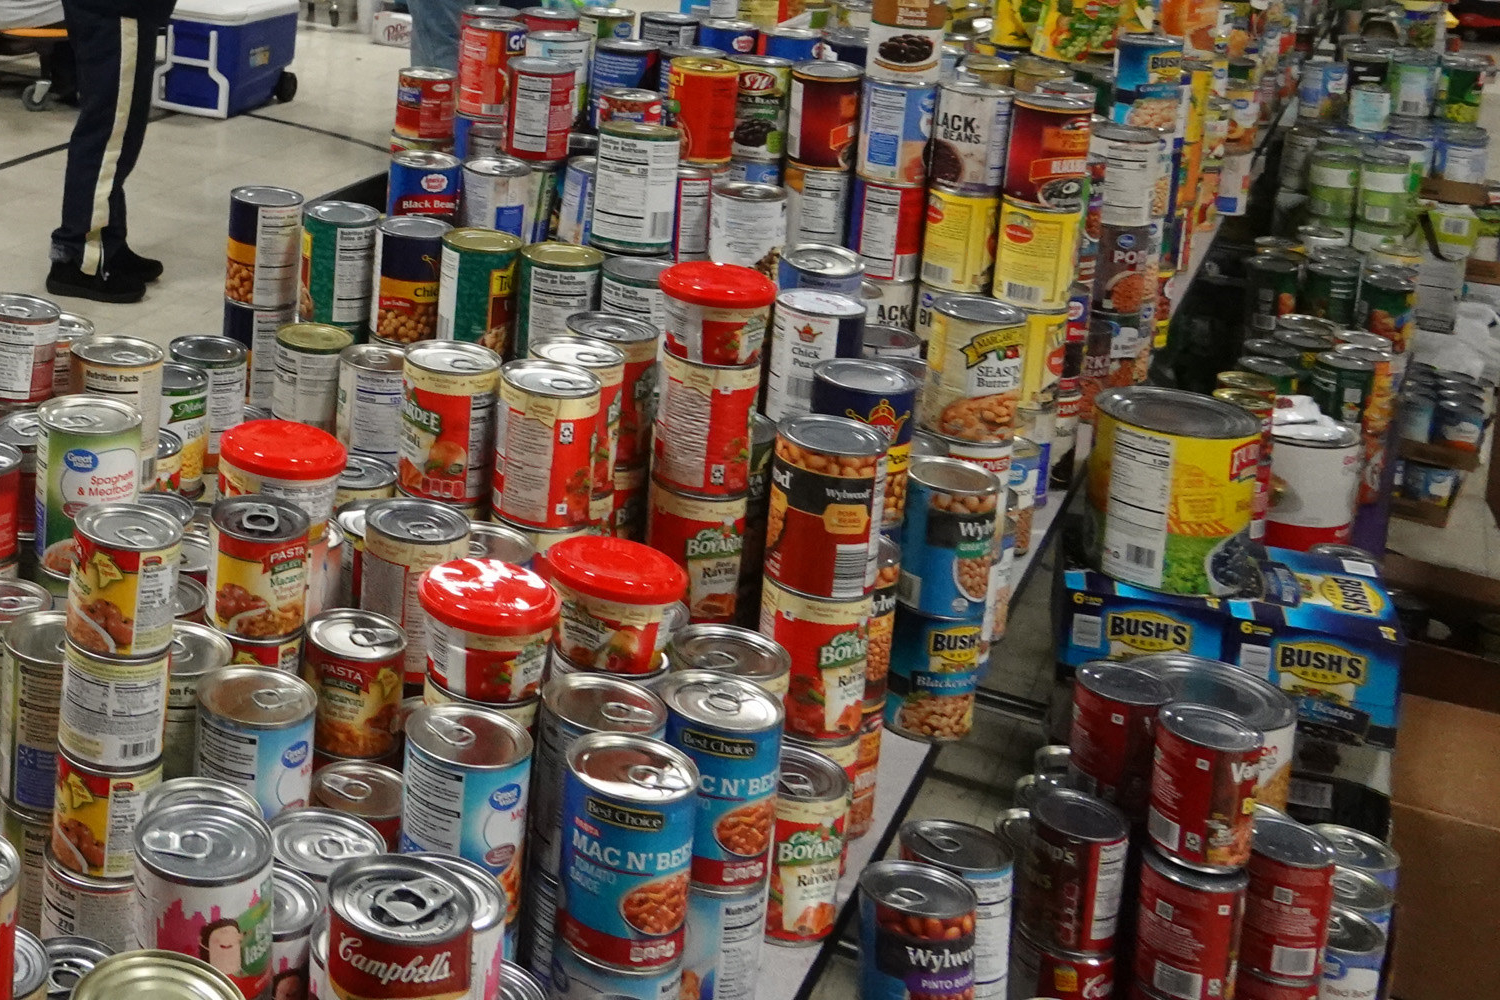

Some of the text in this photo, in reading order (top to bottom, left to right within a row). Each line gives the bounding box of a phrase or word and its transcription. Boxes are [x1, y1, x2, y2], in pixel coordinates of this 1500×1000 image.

[943, 130, 982, 145] BEANS
[402, 199, 429, 210] Black
[792, 346, 820, 359] Chick
[86, 369, 140, 383] Nutrition Facts
[977, 378, 1010, 388] Butter
[67, 451, 93, 463] Great
[77, 481, 134, 497] & Meatballs
[270, 546, 305, 563] PASTA
[1073, 590, 1085, 605] 6
[1111, 616, 1188, 647] BUSH'S
[1240, 620, 1252, 634] 6
[1280, 645, 1363, 680] BUSH'S
[321, 663, 364, 684] PASTA
[683, 732, 755, 756] Best Choice
[587, 800, 663, 829] Best Choice
[573, 828, 621, 866] MAC
[626, 851, 654, 870] N'
[58, 918, 75, 931] 270
[338, 932, 454, 985] Campbell's
[922, 979, 953, 990] PINTO
